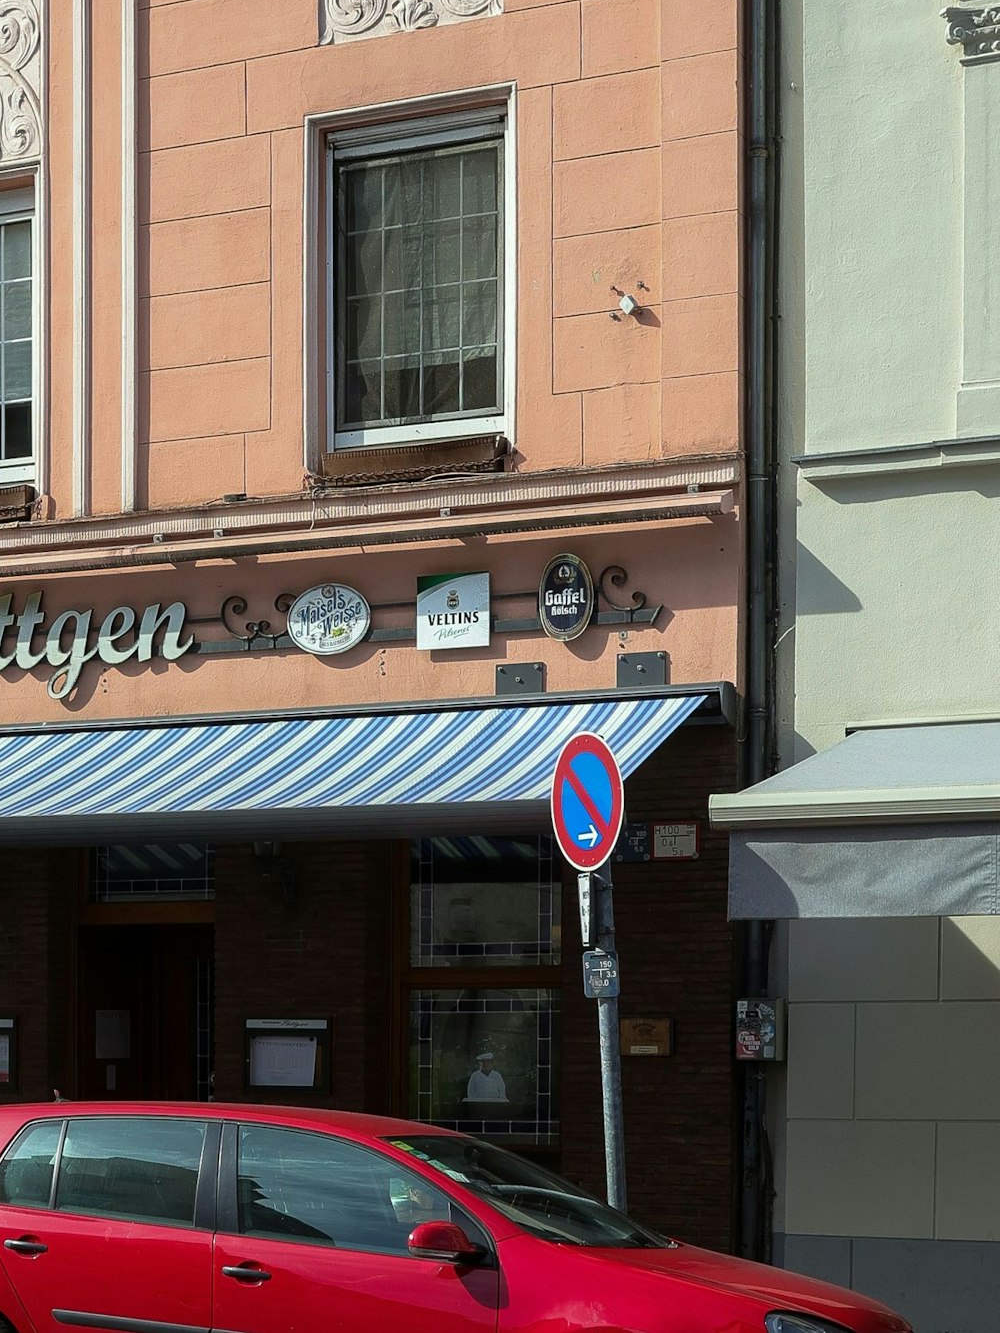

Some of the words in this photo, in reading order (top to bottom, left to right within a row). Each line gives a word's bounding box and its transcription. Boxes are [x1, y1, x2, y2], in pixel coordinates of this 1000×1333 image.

[545, 588, 586, 606] Gaffel
[295, 587, 346, 638] Maisel's
[551, 605, 578, 616] Kölsch
[317, 601, 362, 638] Weisse
[428, 611, 479, 627] VELTINS
[433, 625, 472, 641] Pilsener
[606, 970, 617, 978] 3.3
